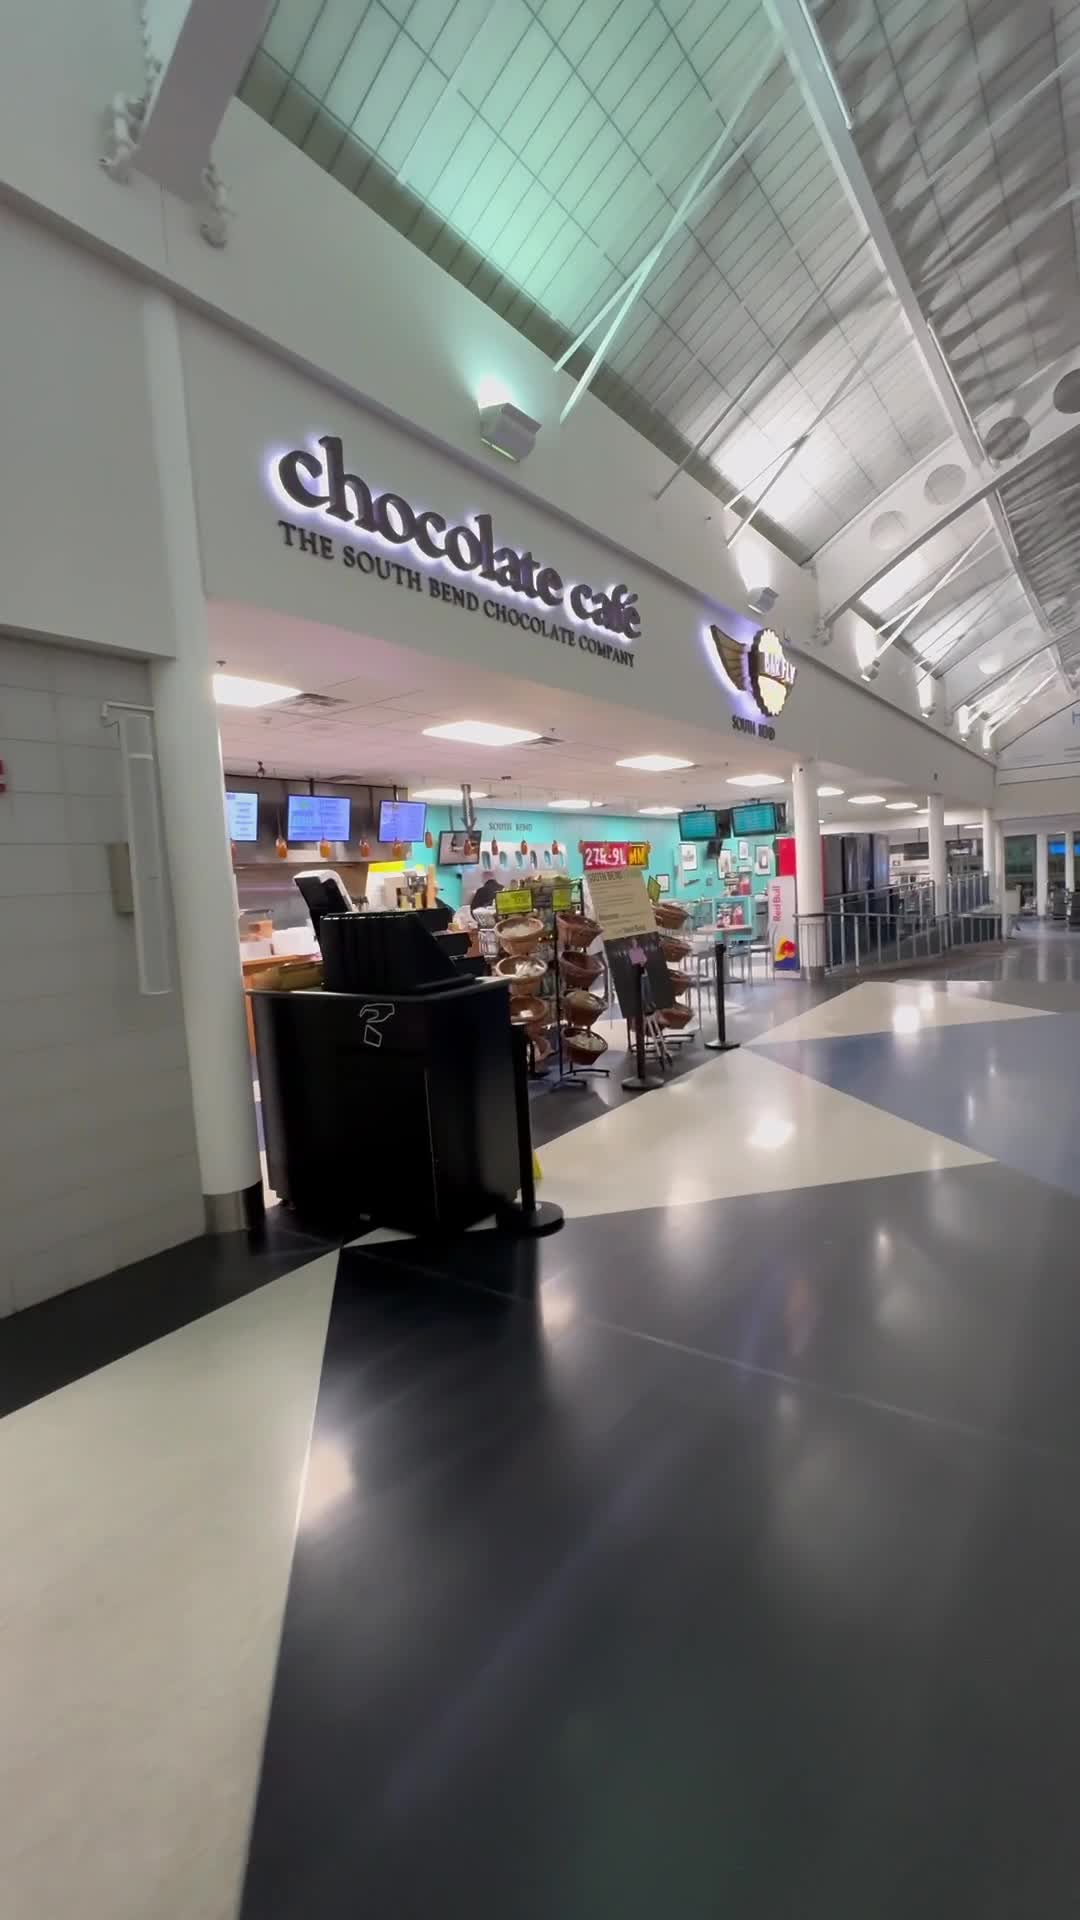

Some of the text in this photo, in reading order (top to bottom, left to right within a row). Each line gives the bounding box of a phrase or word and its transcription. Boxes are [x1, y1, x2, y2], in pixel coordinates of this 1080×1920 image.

[278, 435, 642, 640] chocolate café
[278, 520, 636, 668] THE SOUTH BEND CHOCOLATE COMPANY
